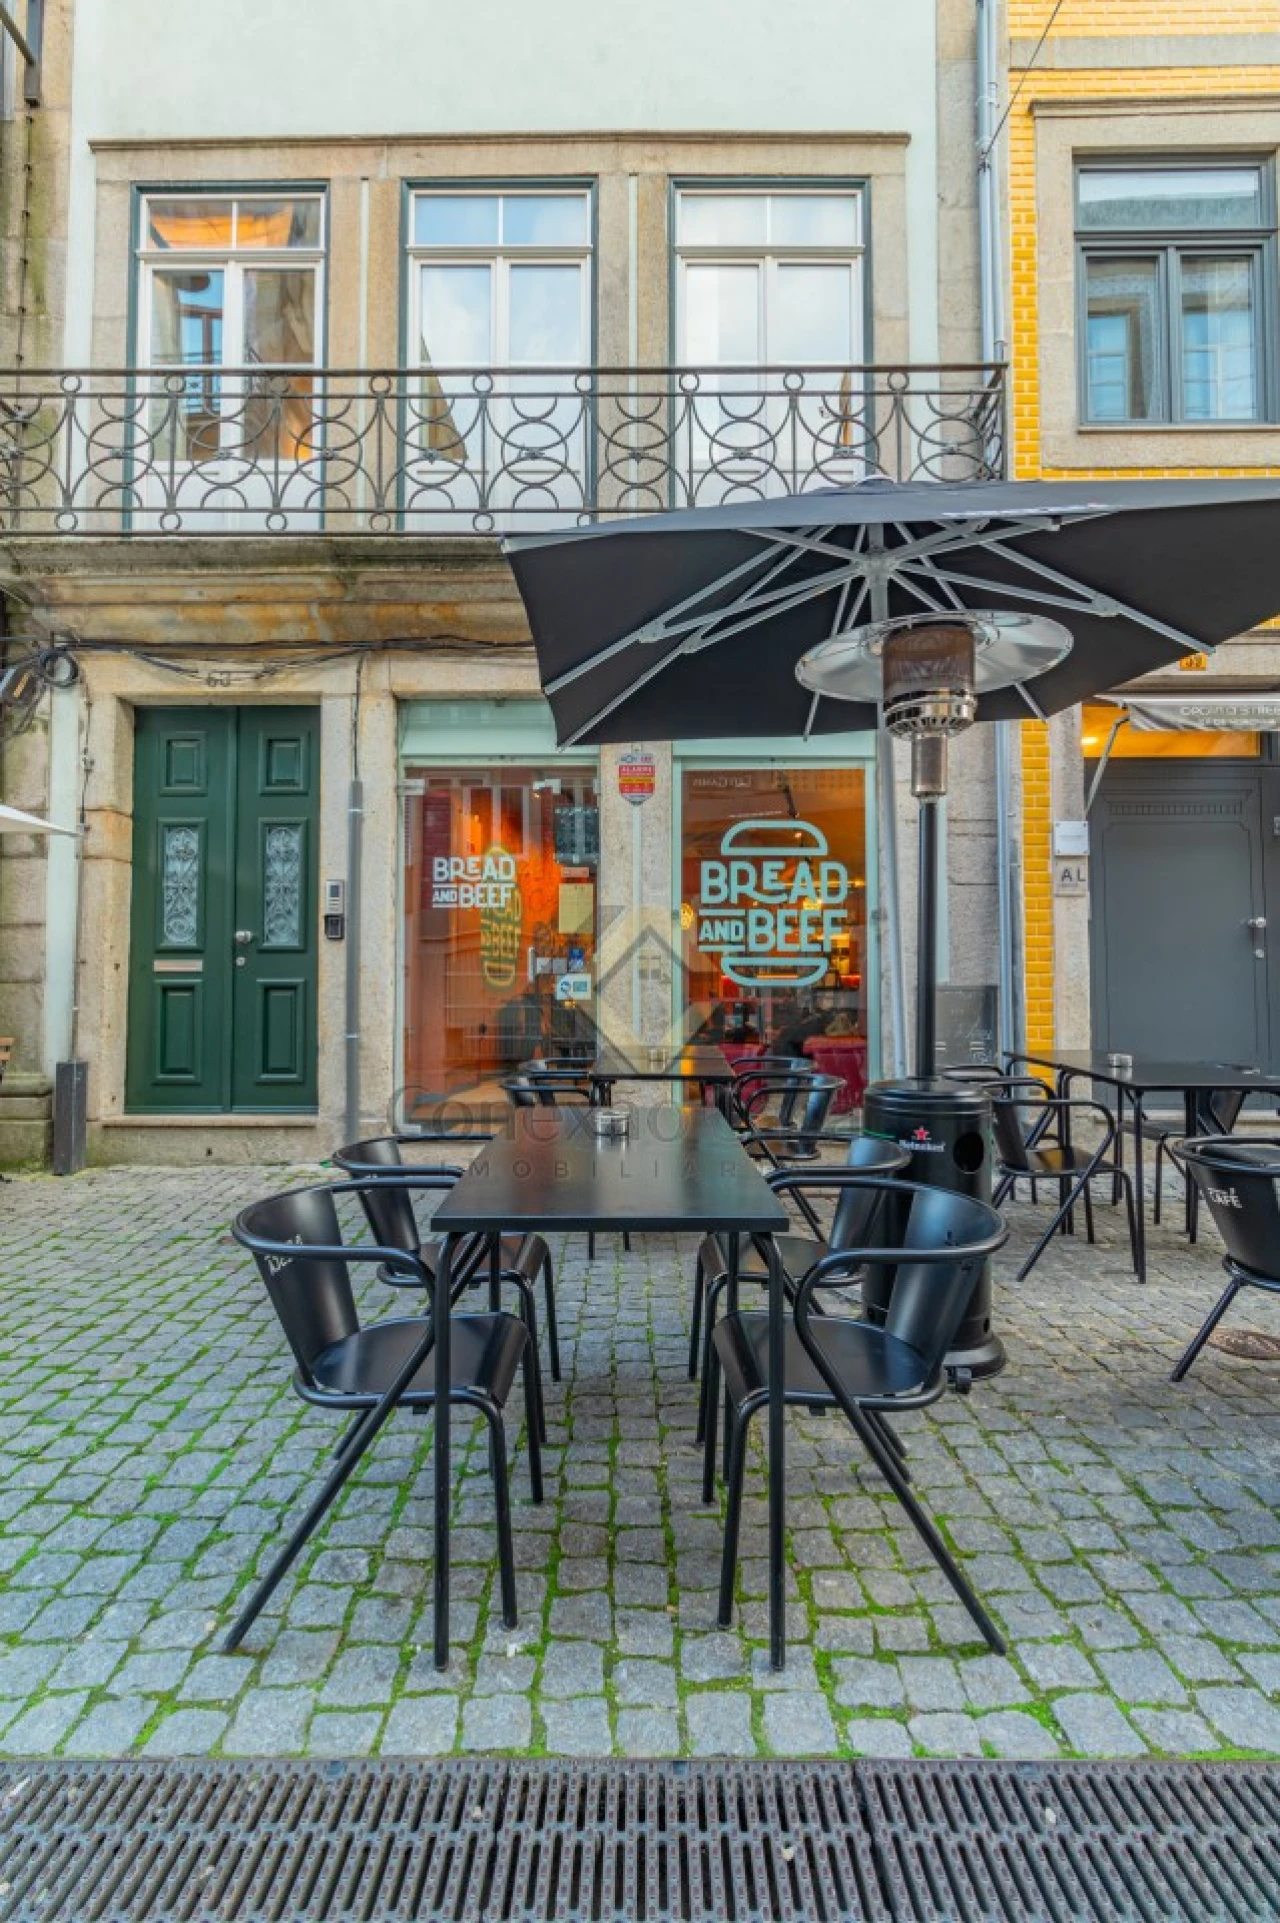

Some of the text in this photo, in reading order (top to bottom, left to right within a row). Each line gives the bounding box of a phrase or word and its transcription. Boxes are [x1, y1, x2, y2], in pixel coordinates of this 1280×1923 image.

[432, 856, 516, 882] BREAD
[700, 860, 848, 904] BREAD
[432, 890, 458, 902] AND
[459, 883, 515, 909] BEEF
[699, 908, 848, 953] AND BEEF
